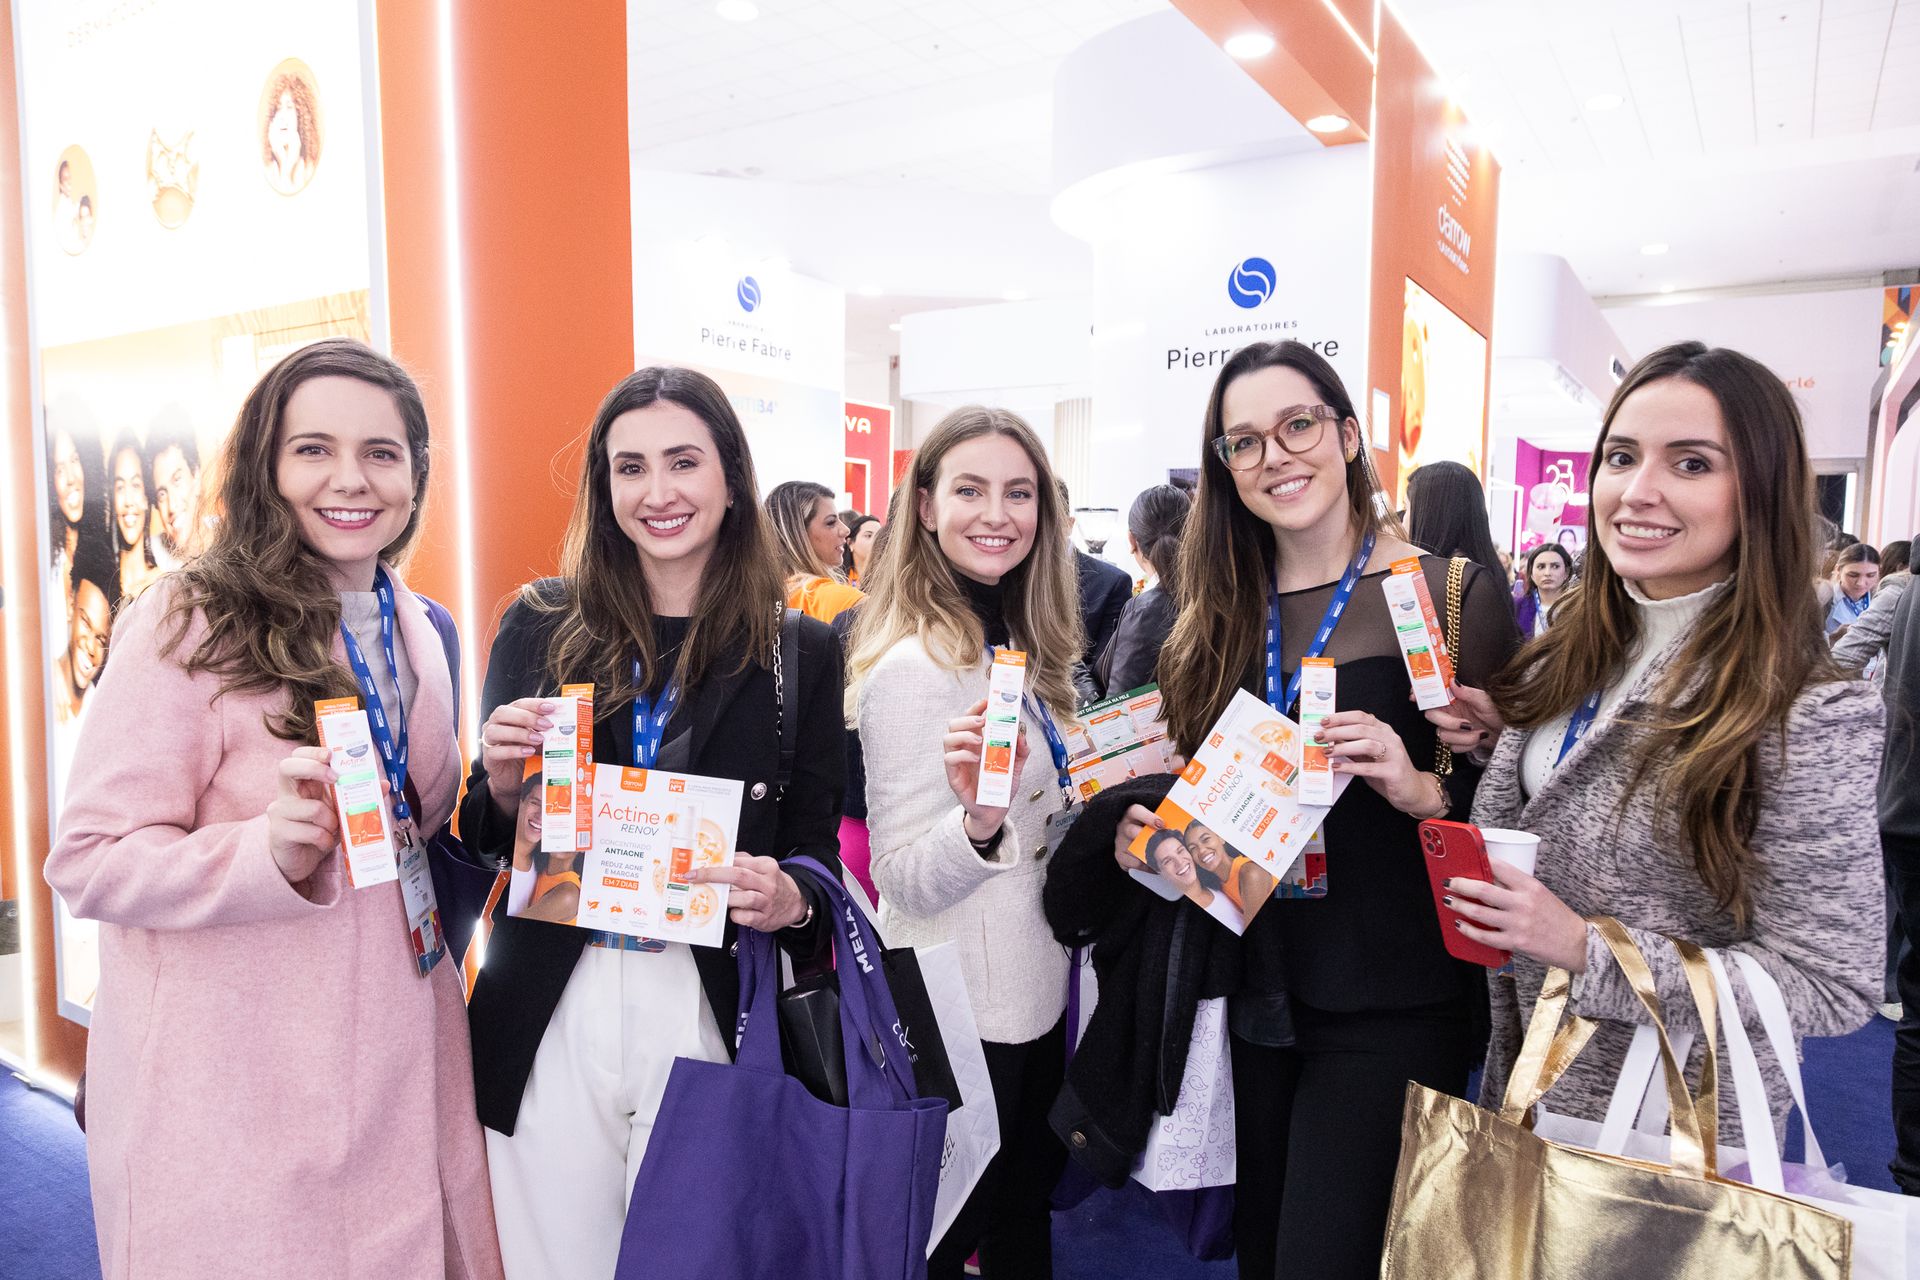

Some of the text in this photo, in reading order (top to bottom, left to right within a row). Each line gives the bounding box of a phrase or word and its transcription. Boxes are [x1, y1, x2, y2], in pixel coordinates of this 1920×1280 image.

[1205, 320, 1299, 336] LABORATOIRES
[752, 338, 792, 361] Fabre
[1167, 347, 1231, 370] Pierr
[1198, 764, 1237, 816] Actine
[1221, 769, 1244, 802] RENOV
[598, 802, 660, 825] Actine
[1231, 791, 1256, 824] ANTIACNE
[620, 823, 659, 836] RENOV
[1254, 826, 1263, 838] EM
[1263, 808, 1277, 824] DIAS
[600, 839, 652, 851] CONCENTRADO
[604, 847, 645, 859] ANTIACNE
[600, 860, 644, 872] REDUZ ACNE
[610, 869, 640, 879] MARCAS
[604, 878, 616, 886] EM
[620, 880, 638, 889] DIAS
